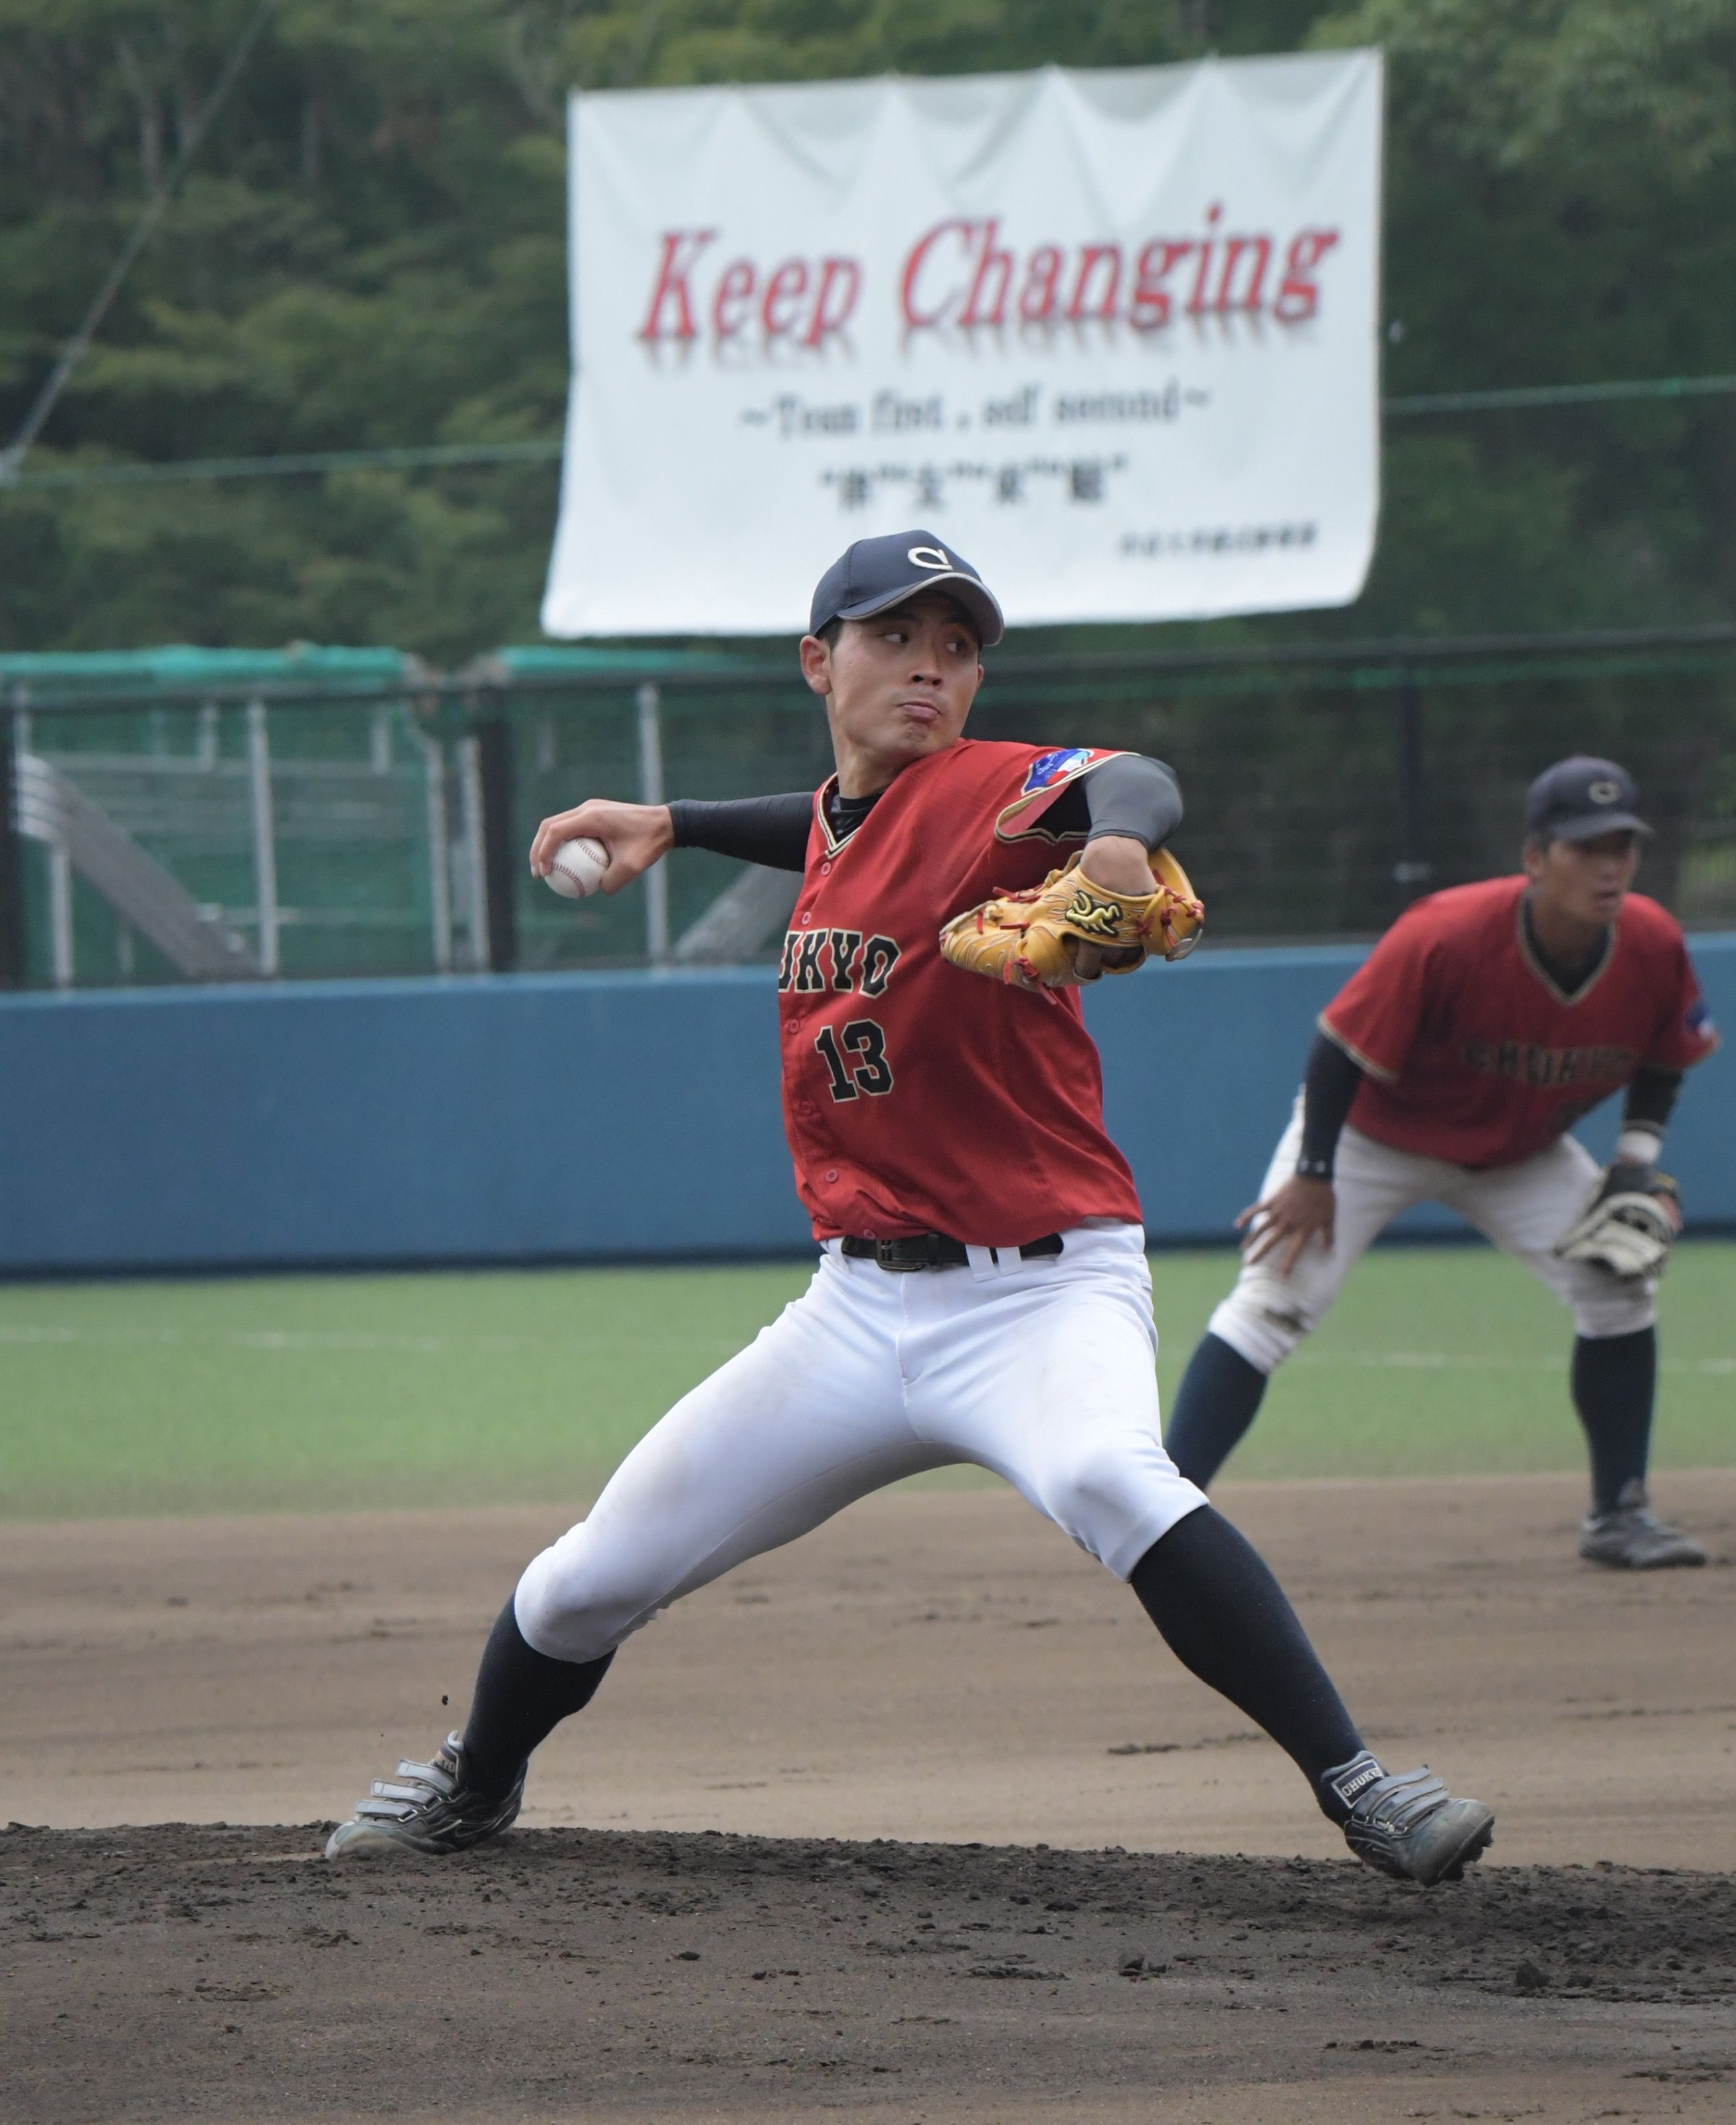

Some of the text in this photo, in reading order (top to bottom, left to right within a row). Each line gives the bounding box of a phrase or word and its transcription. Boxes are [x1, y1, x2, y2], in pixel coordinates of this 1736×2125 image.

[636, 201, 1339, 349] Keep Changing
[814, 1018, 895, 1103] 13
